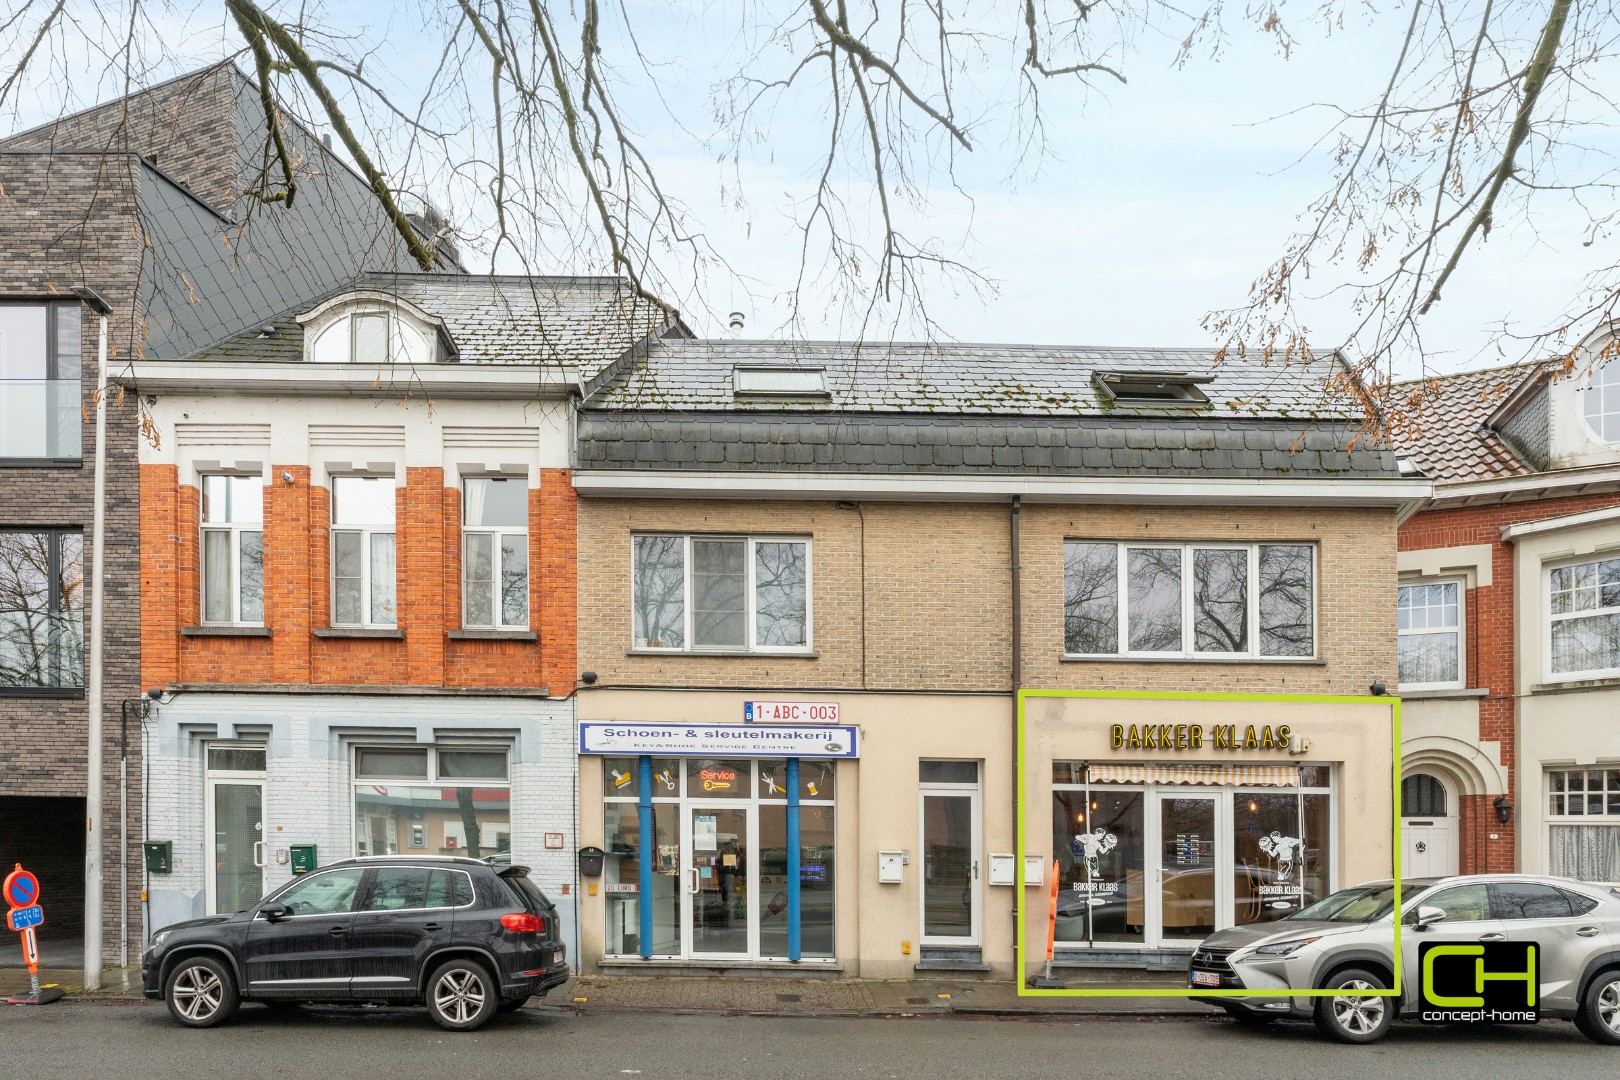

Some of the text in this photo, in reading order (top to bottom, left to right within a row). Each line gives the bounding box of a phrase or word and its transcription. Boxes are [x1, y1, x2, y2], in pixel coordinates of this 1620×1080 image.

[603, 728, 833, 742] Schoen- & sleutelmakerij
[1111, 724, 1291, 749] BAKKER KLAAS
[701, 770, 735, 780] Service
